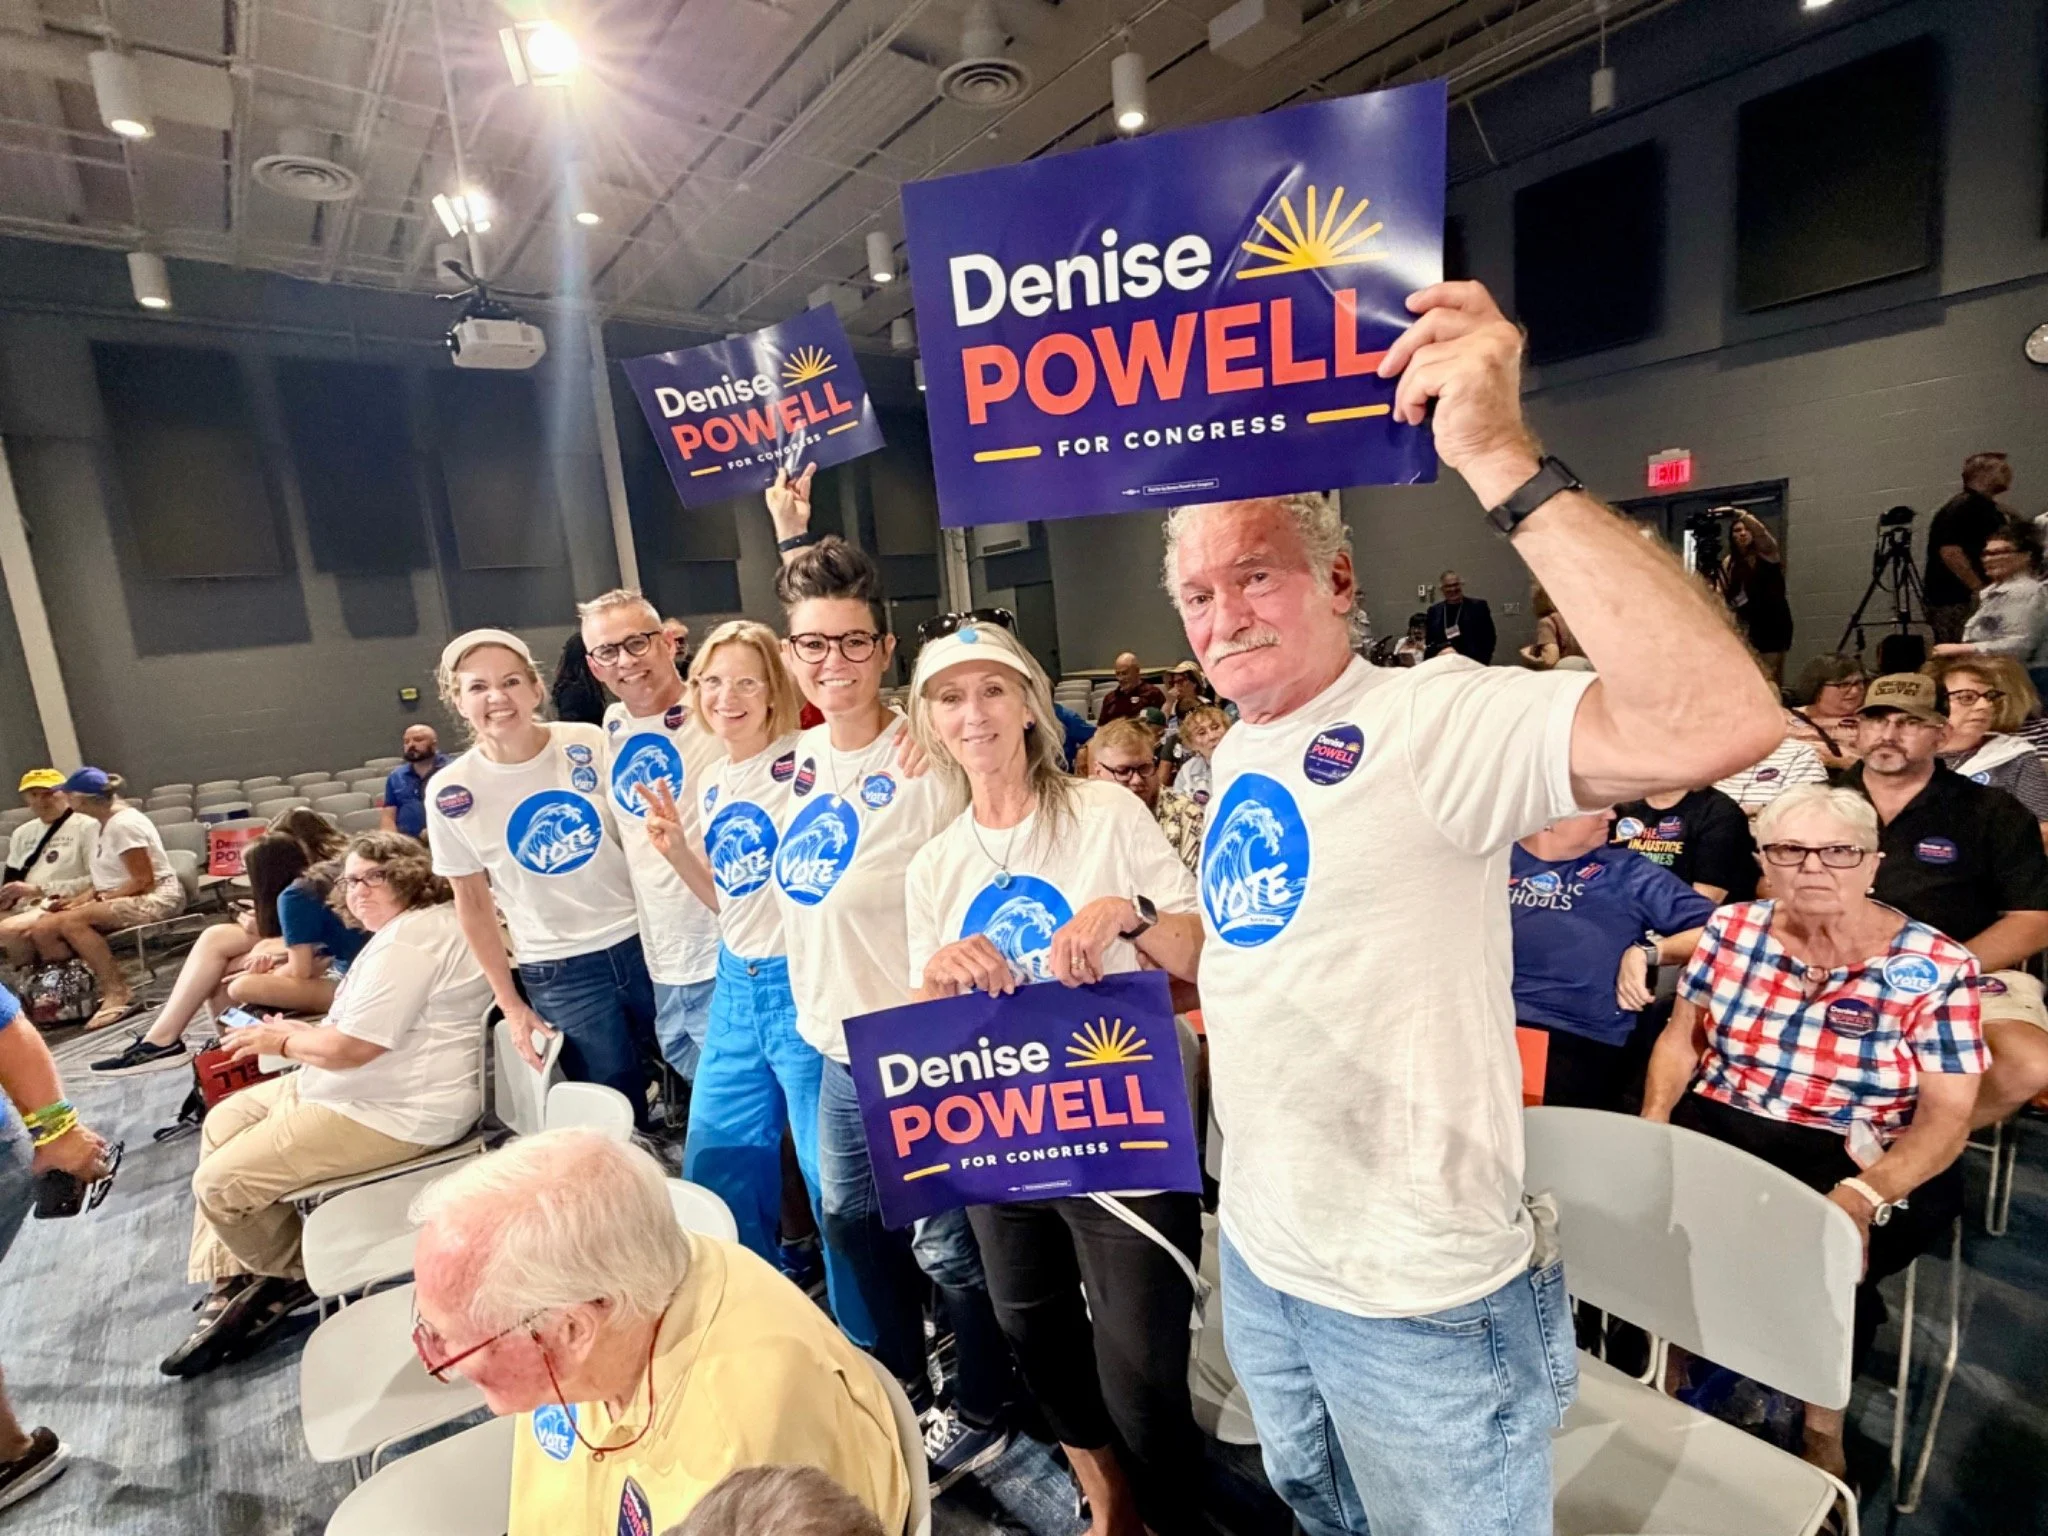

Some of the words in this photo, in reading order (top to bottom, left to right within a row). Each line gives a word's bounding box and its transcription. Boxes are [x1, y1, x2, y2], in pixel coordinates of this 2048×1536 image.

[950, 228, 1212, 327] Denise
[961, 287, 1390, 425] POWELL
[654, 374, 778, 419] Denise
[671, 381, 853, 461] POWELL
[1057, 435, 1110, 457] FOR
[1124, 413, 1287, 449] CONGRESS
[727, 458, 752, 470] FOR
[757, 433, 821, 463] CONGRESS
[1656, 462, 1685, 483] EXIT
[1311, 743, 1355, 765] POWELL
[865, 791, 890, 802] VOTE
[528, 822, 596, 870] VOTE
[1627, 839, 1685, 855] INJUSTICE
[714, 847, 771, 889] VOTE
[780, 858, 840, 885] VOTE
[1208, 862, 1293, 924] VOTE
[1508, 887, 1573, 911] HOOLS
[1891, 972, 1931, 988] VOTE
[877, 1036, 1050, 1099] Denise
[889, 1074, 1165, 1158] POWELL
[960, 1154, 998, 1170] FOR
[1006, 1142, 1110, 1164] CONGRESS
[538, 1427, 570, 1452] VOTE
